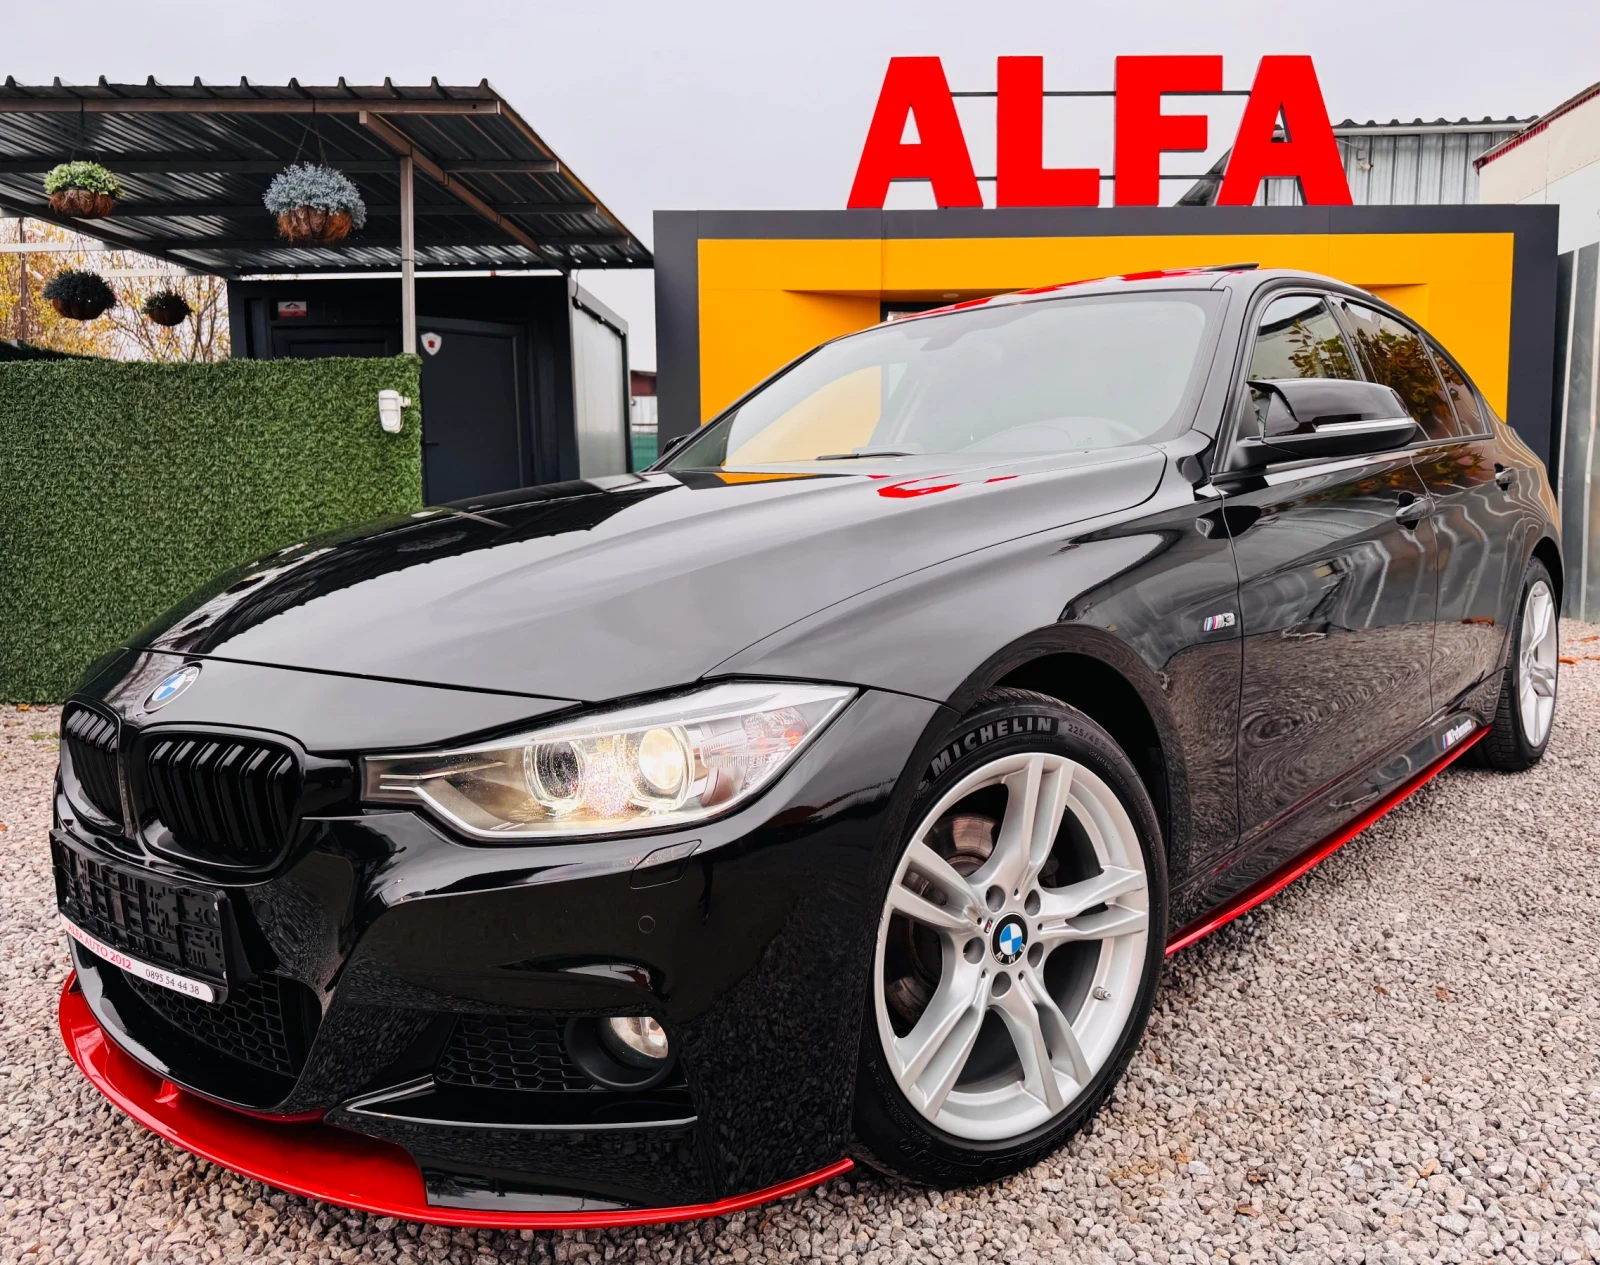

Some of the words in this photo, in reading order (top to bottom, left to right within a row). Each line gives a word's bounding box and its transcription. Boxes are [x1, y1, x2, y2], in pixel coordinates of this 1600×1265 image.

[847, 55, 1353, 209] ALFA
[930, 716, 1052, 777] MICHELIN
[1067, 724, 1100, 746] 225/45
[67, 923, 84, 942] ALFA
[85, 938, 108, 957] AUTO
[110, 951, 132, 970] 2012
[145, 968, 164, 982] 0895
[165, 976, 175, 987] 54
[177, 980, 188, 991] 44
[189, 983, 200, 995] 38
